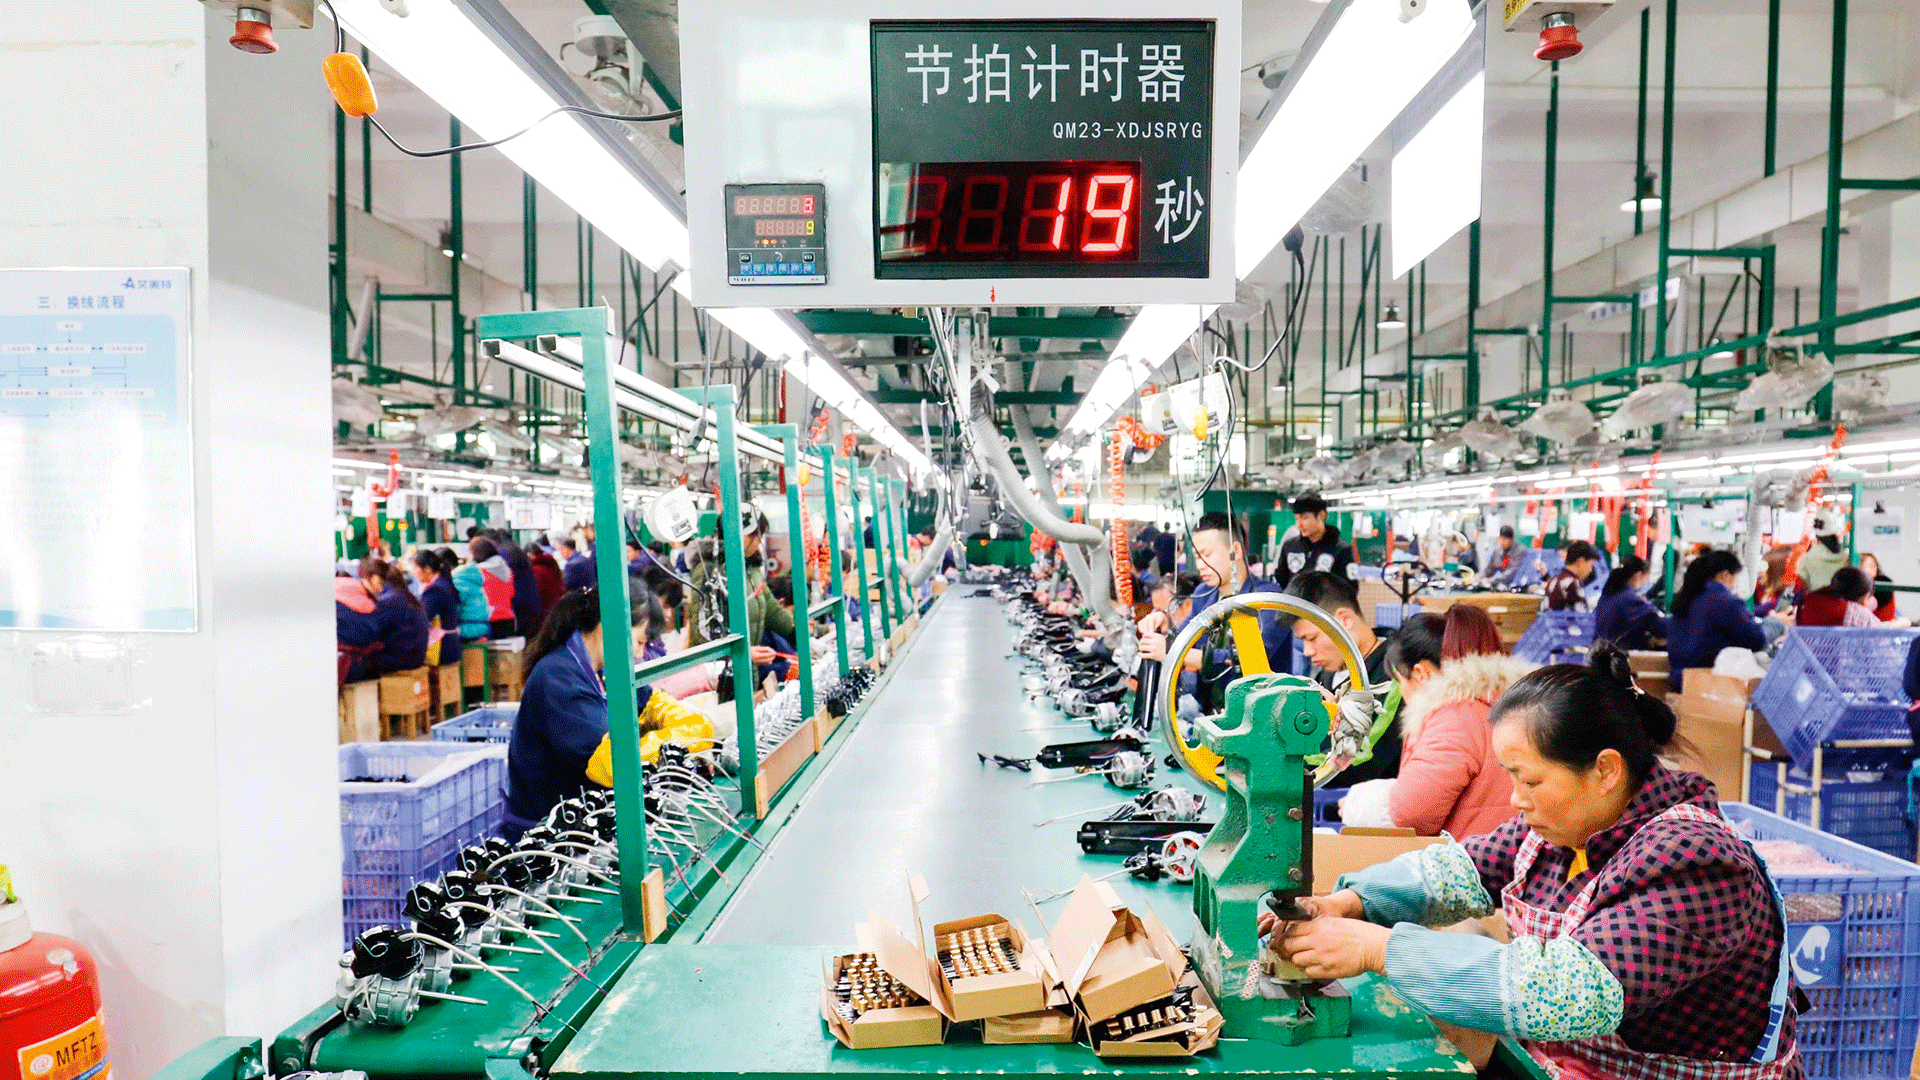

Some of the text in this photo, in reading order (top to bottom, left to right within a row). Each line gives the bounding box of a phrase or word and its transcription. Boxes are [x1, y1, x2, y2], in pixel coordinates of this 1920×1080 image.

[906, 43, 1185, 103] 节拍计时器
[1052, 122, 1203, 140] QM23-XDJSRYG
[1051, 174, 1133, 252] 19
[1154, 176, 1205, 245] 秒
[56, 1031, 97, 1067] MFTZ
